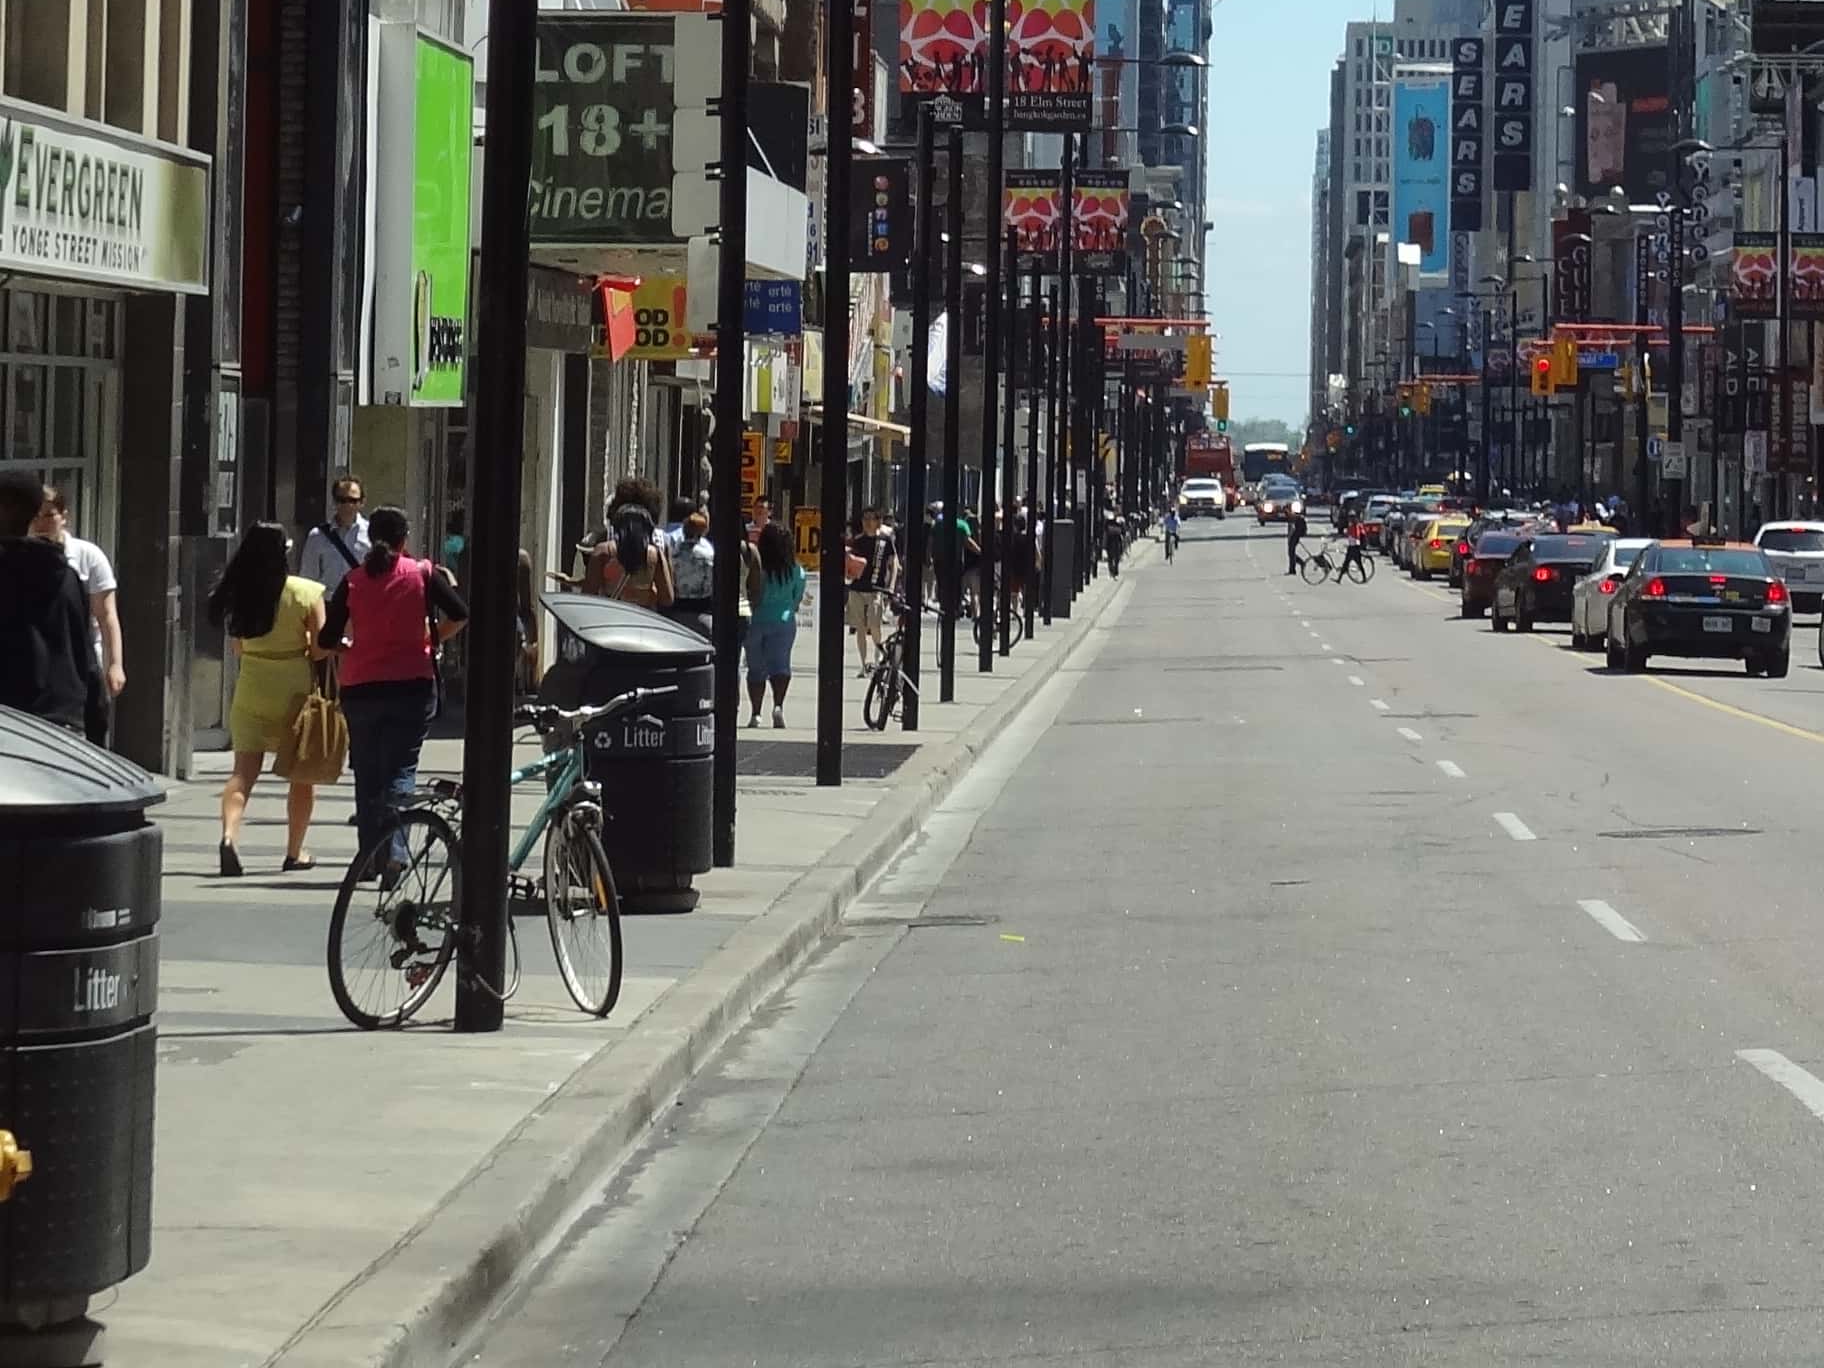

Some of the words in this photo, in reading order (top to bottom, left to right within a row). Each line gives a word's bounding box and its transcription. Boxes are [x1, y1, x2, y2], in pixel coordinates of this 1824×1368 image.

[1056, 96, 1088, 108] Street
[1457, 42, 1478, 193] SEARS
[537, 103, 671, 157] 18+
[15, 126, 144, 232] EVERGREEN
[11, 225, 49, 259] YONGE
[55, 232, 98, 265] STREET
[624, 725, 666, 748] Litter
[73, 966, 121, 1011] Litter
